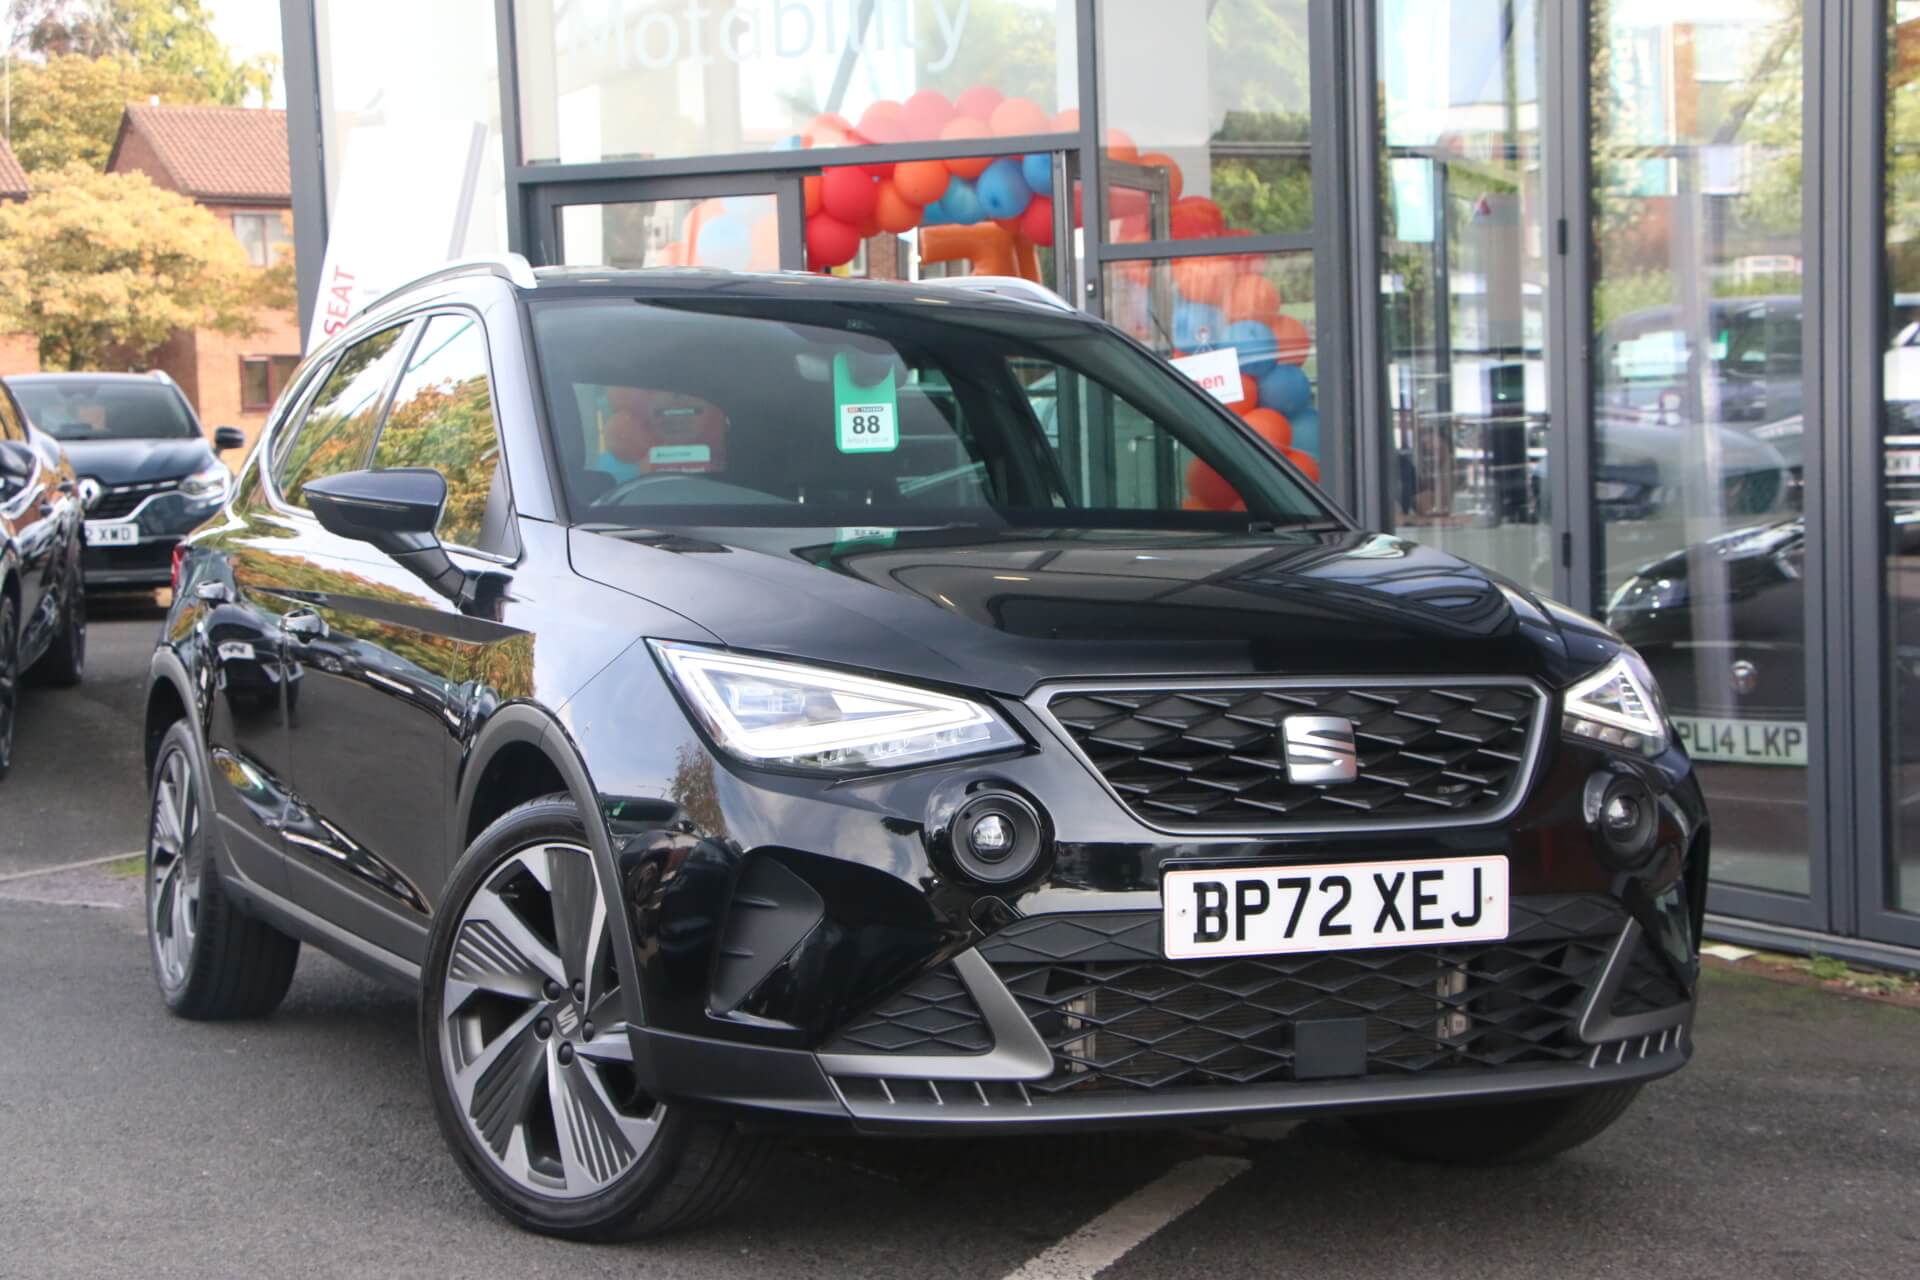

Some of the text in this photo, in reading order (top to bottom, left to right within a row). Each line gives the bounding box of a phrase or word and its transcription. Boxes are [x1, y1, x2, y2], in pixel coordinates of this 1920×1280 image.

[323, 264, 355, 335] SEAT
[1194, 373, 1225, 390] en
[852, 415, 881, 435] 88
[1677, 721, 1803, 758] PL14 LKP
[1192, 867, 1483, 944] BP72 XEJ
